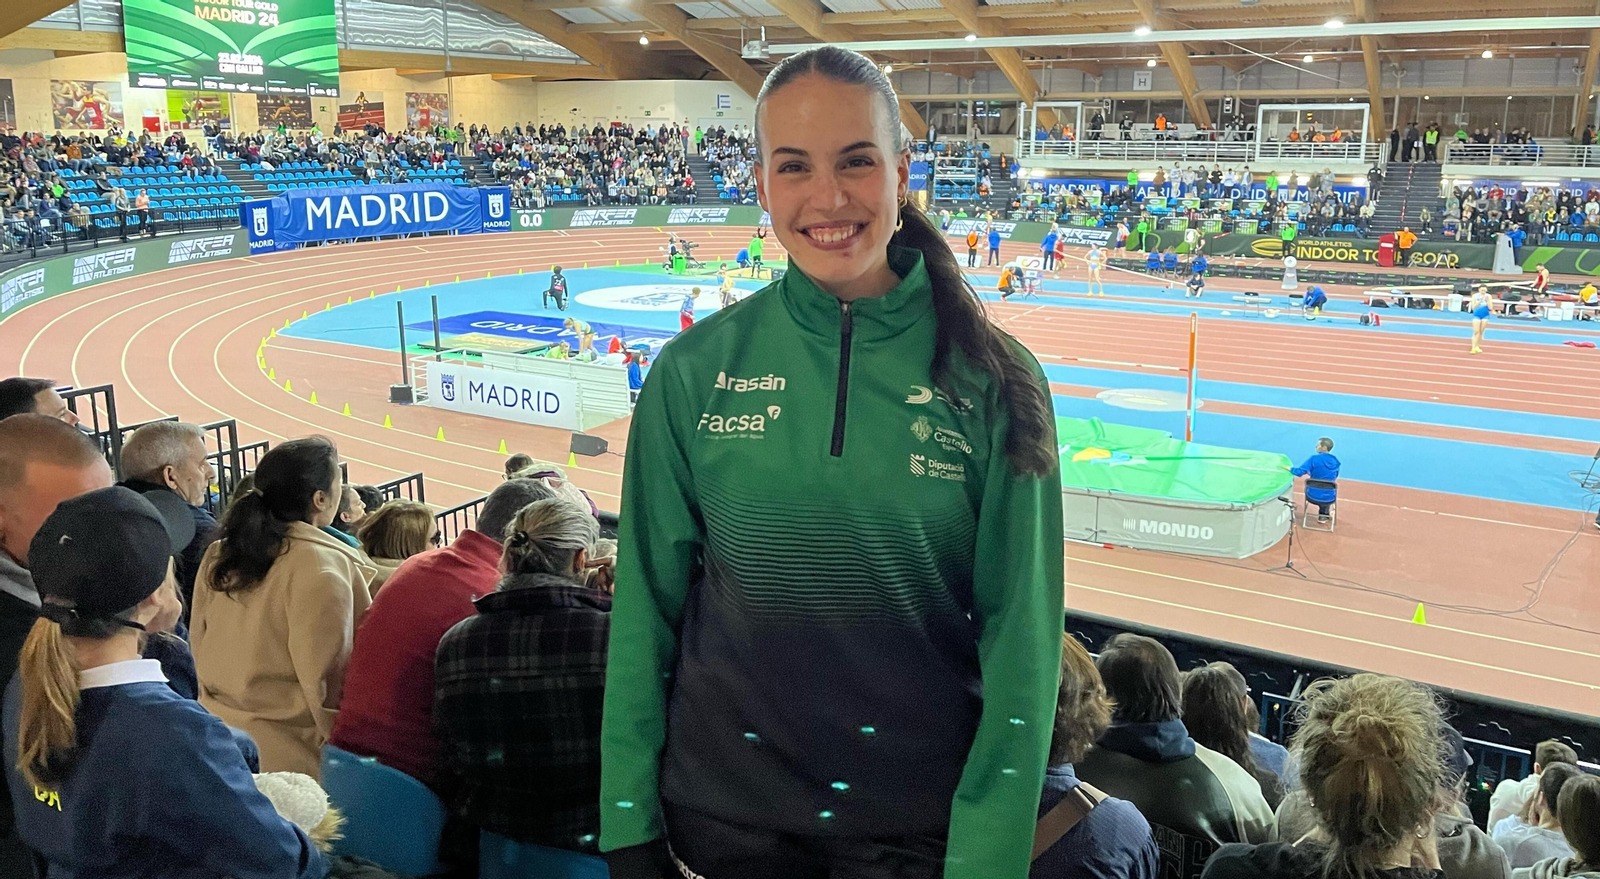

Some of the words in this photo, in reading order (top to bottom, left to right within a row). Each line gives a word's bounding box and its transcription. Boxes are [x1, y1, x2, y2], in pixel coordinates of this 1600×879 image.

[194, 5, 256, 25] MADRID
[257, 12, 280, 27] 24
[1138, 77, 1147, 87] H
[304, 191, 449, 231] MADRID
[596, 208, 638, 220] RFEA
[690, 207, 731, 218] RFEA
[483, 220, 511, 229] MADRID
[520, 213, 543, 228] 0.0
[1070, 228, 1113, 241] RFEA
[192, 234, 235, 252] RFEA
[248, 238, 275, 250] MADRID
[95, 247, 136, 270] RFEA
[189, 247, 232, 260] ATLETISMO
[1296, 246, 1359, 261] INDOOR
[93, 264, 134, 280] ATLETISMO
[15, 267, 45, 293] RFEA
[468, 380, 561, 415] MADRID
[697, 413, 765, 433] Facsa
[928, 470, 939, 478] de
[1139, 519, 1214, 540] MONDO
